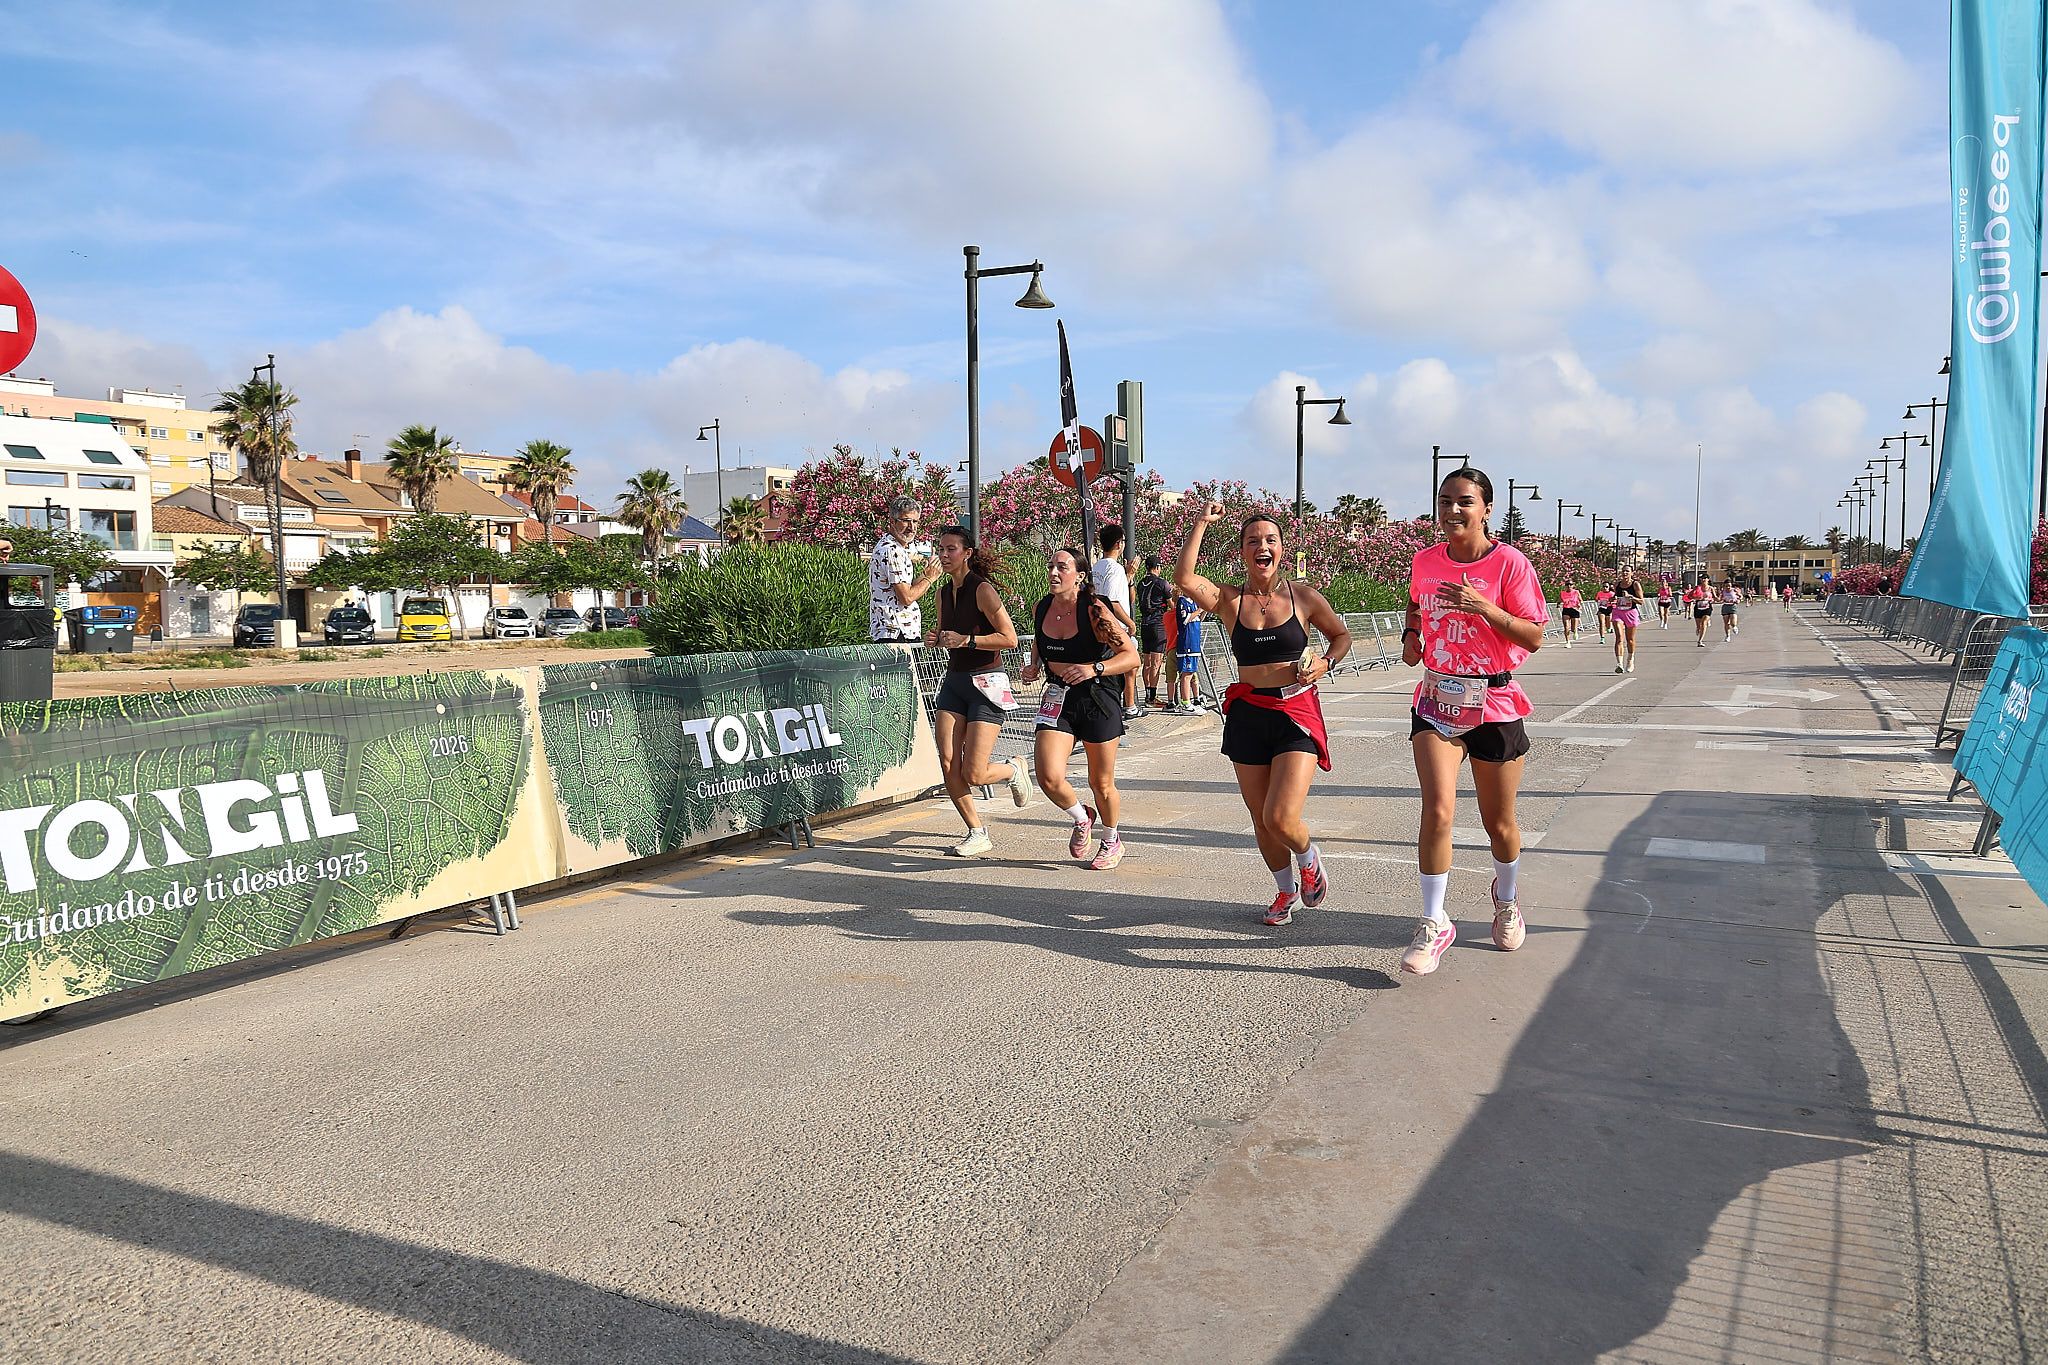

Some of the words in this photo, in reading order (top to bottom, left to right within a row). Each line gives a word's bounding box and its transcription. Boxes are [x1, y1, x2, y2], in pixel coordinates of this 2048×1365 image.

[869, 685, 888, 699] 2026
[585, 709, 613, 728] 1975
[1438, 702, 1461, 716] 016
[429, 735, 469, 758] 2026
[697, 774, 760, 799] Cuidando
[763, 768, 778, 786] de
[780, 766, 791, 782] ti
[792, 759, 824, 780] desde
[826, 757, 849, 777] 1975
[162, 879, 199, 910] de
[204, 873, 227, 902] ti
[230, 858, 309, 897] desde
[316, 851, 369, 884] 1975
